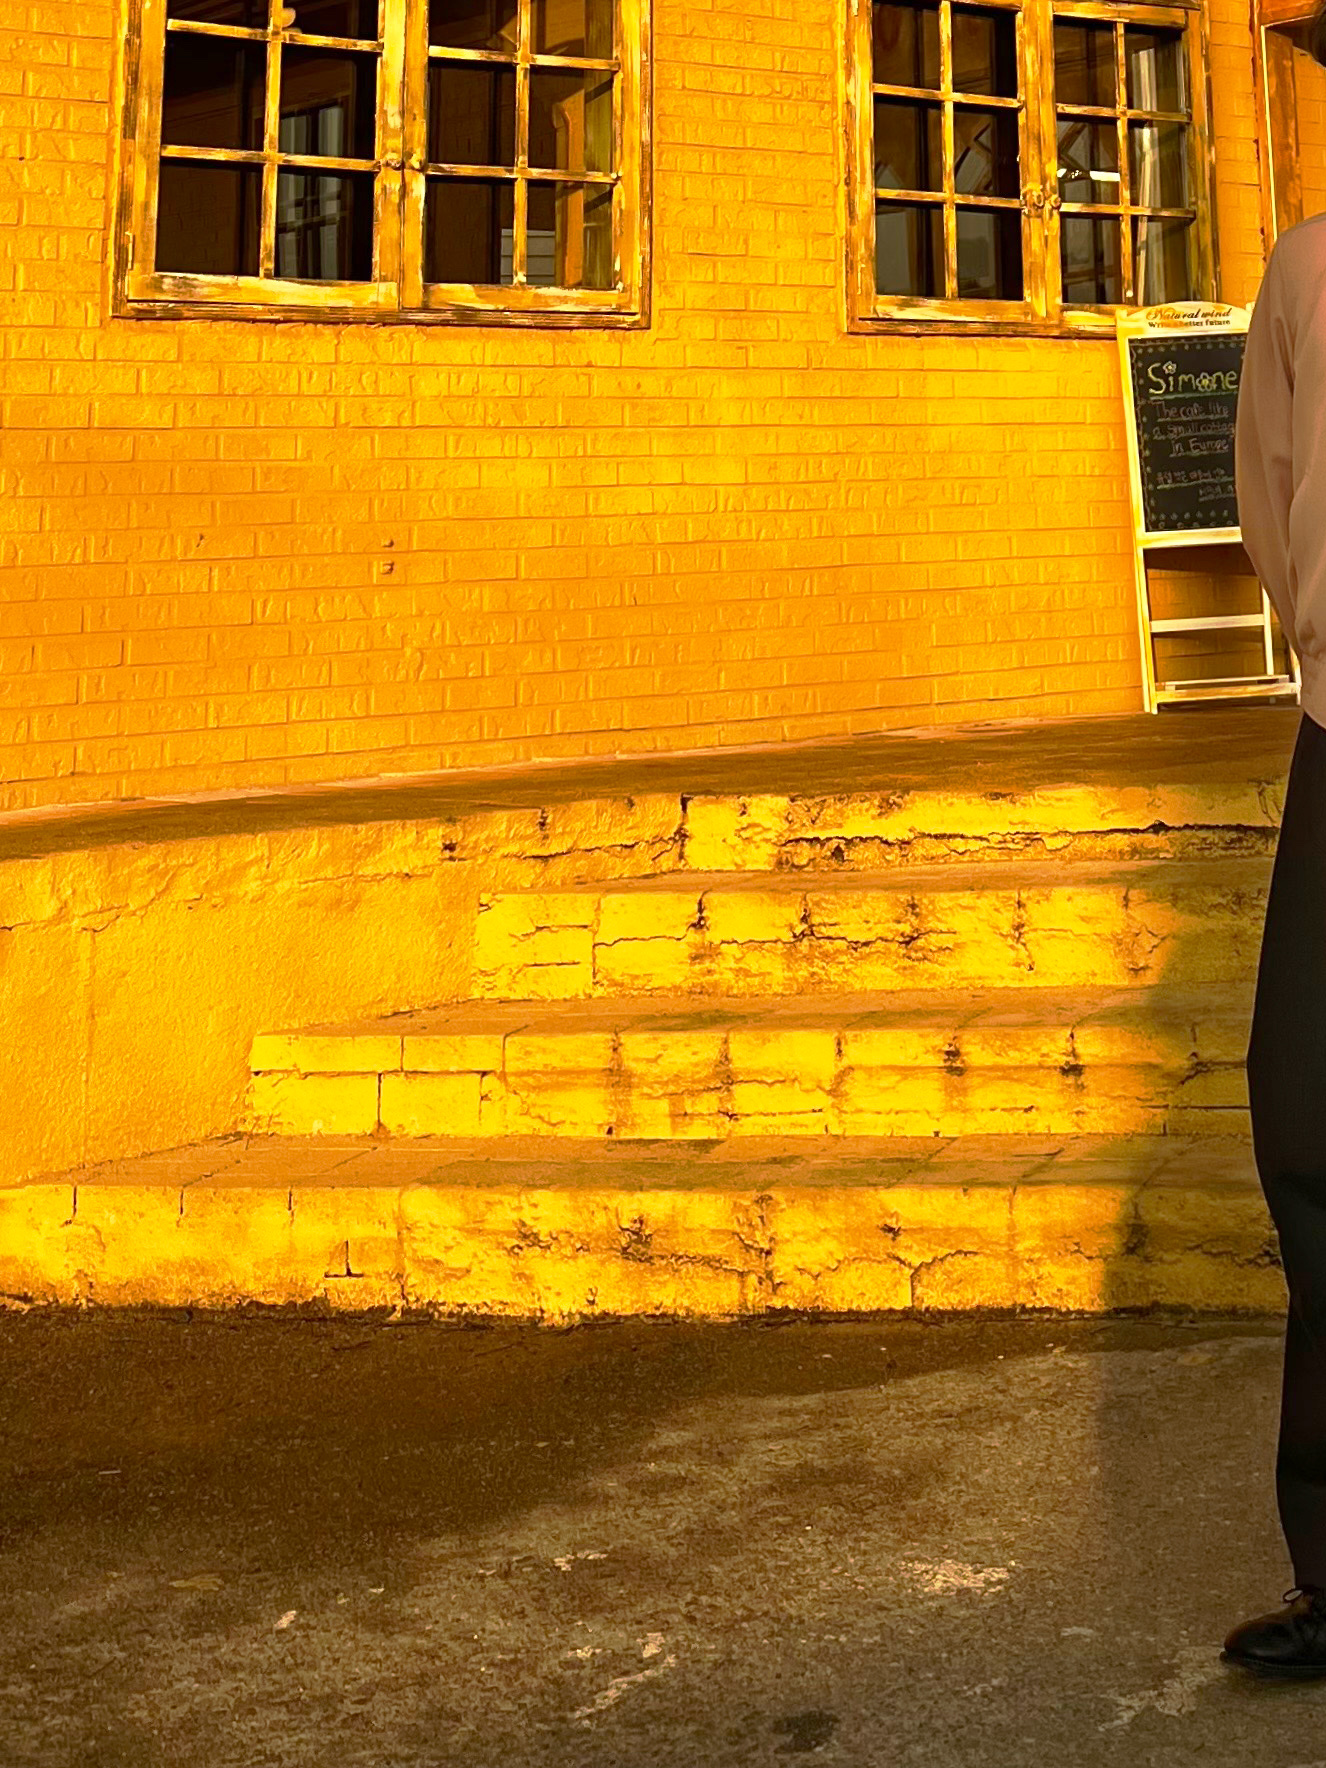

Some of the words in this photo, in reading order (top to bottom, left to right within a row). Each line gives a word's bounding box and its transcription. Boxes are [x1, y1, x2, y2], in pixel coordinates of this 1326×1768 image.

[1146, 307, 1201, 321] Natural
[1201, 308, 1232, 318] wind
[1147, 361, 1238, 394] Simone
